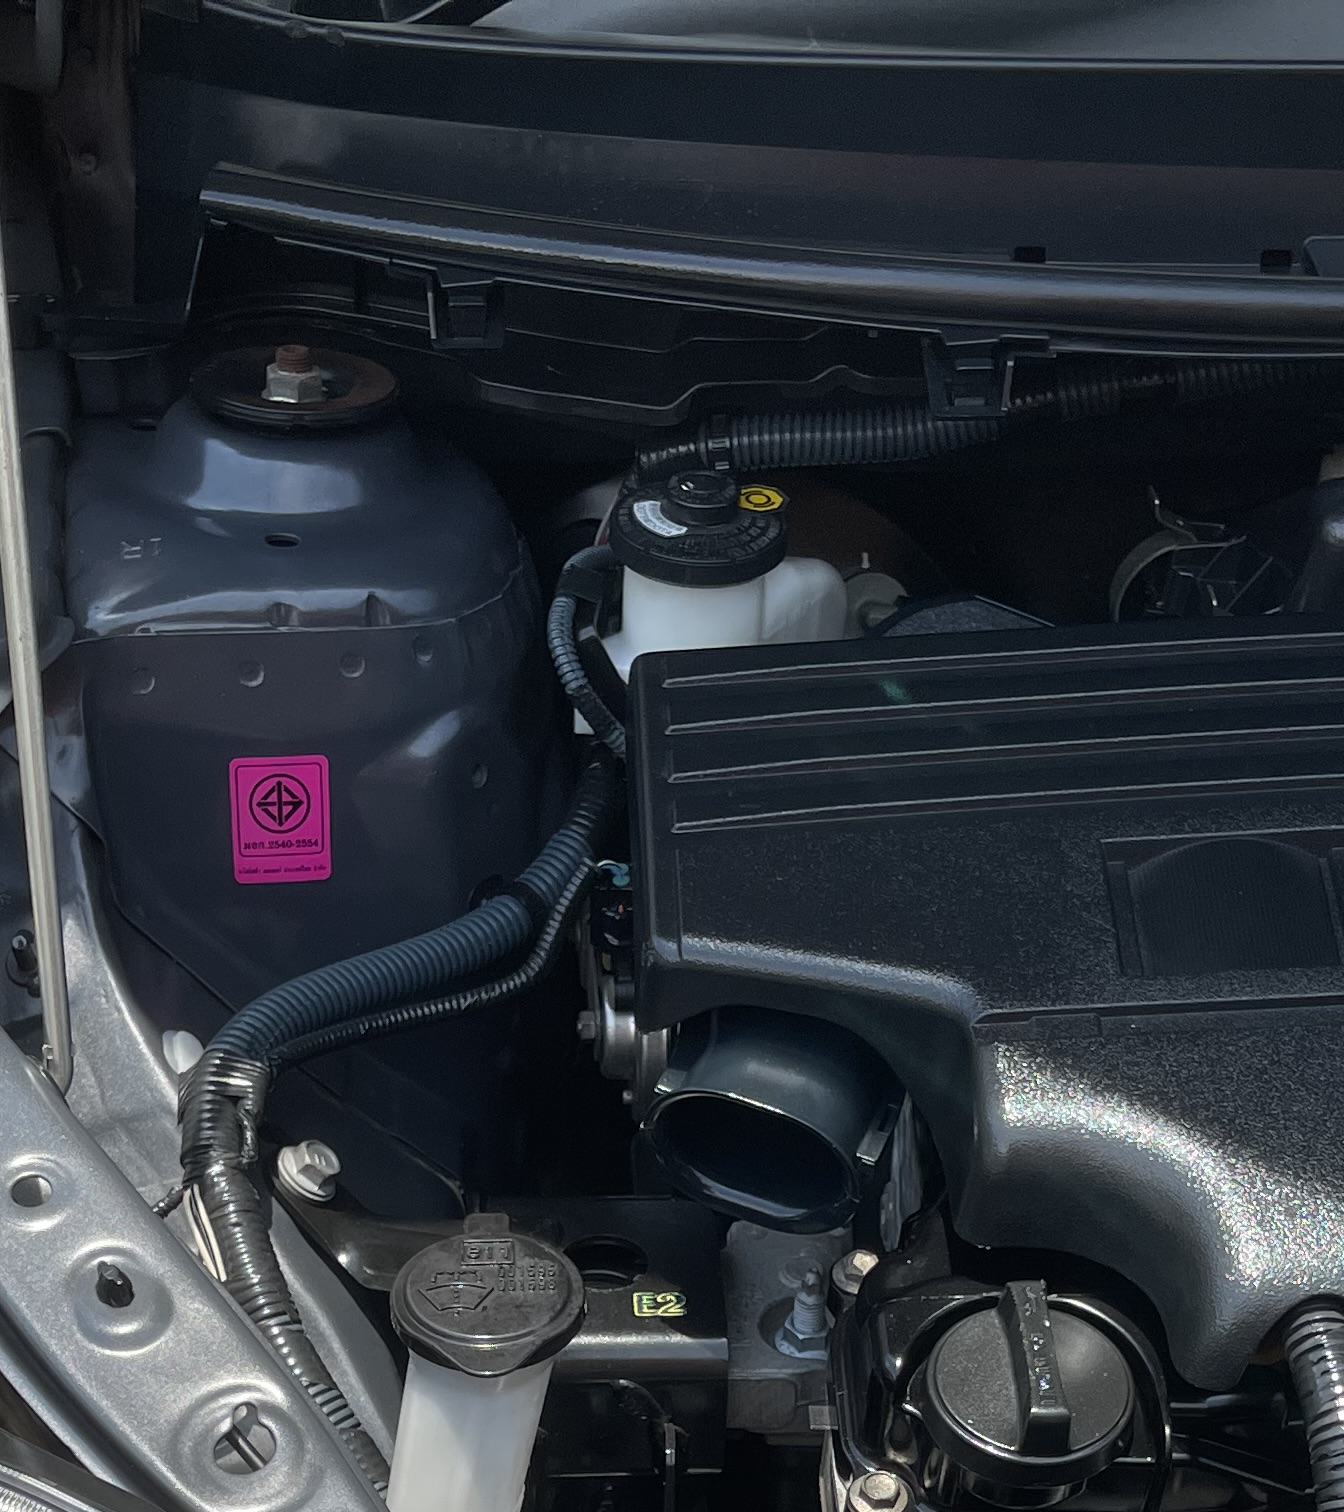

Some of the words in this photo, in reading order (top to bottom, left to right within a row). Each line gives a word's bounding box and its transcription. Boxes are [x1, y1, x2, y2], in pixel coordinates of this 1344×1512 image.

[267, 838, 319, 849] 2540-2554
[466, 1245, 509, 1259] e11
[632, 1291, 687, 1317] E2
